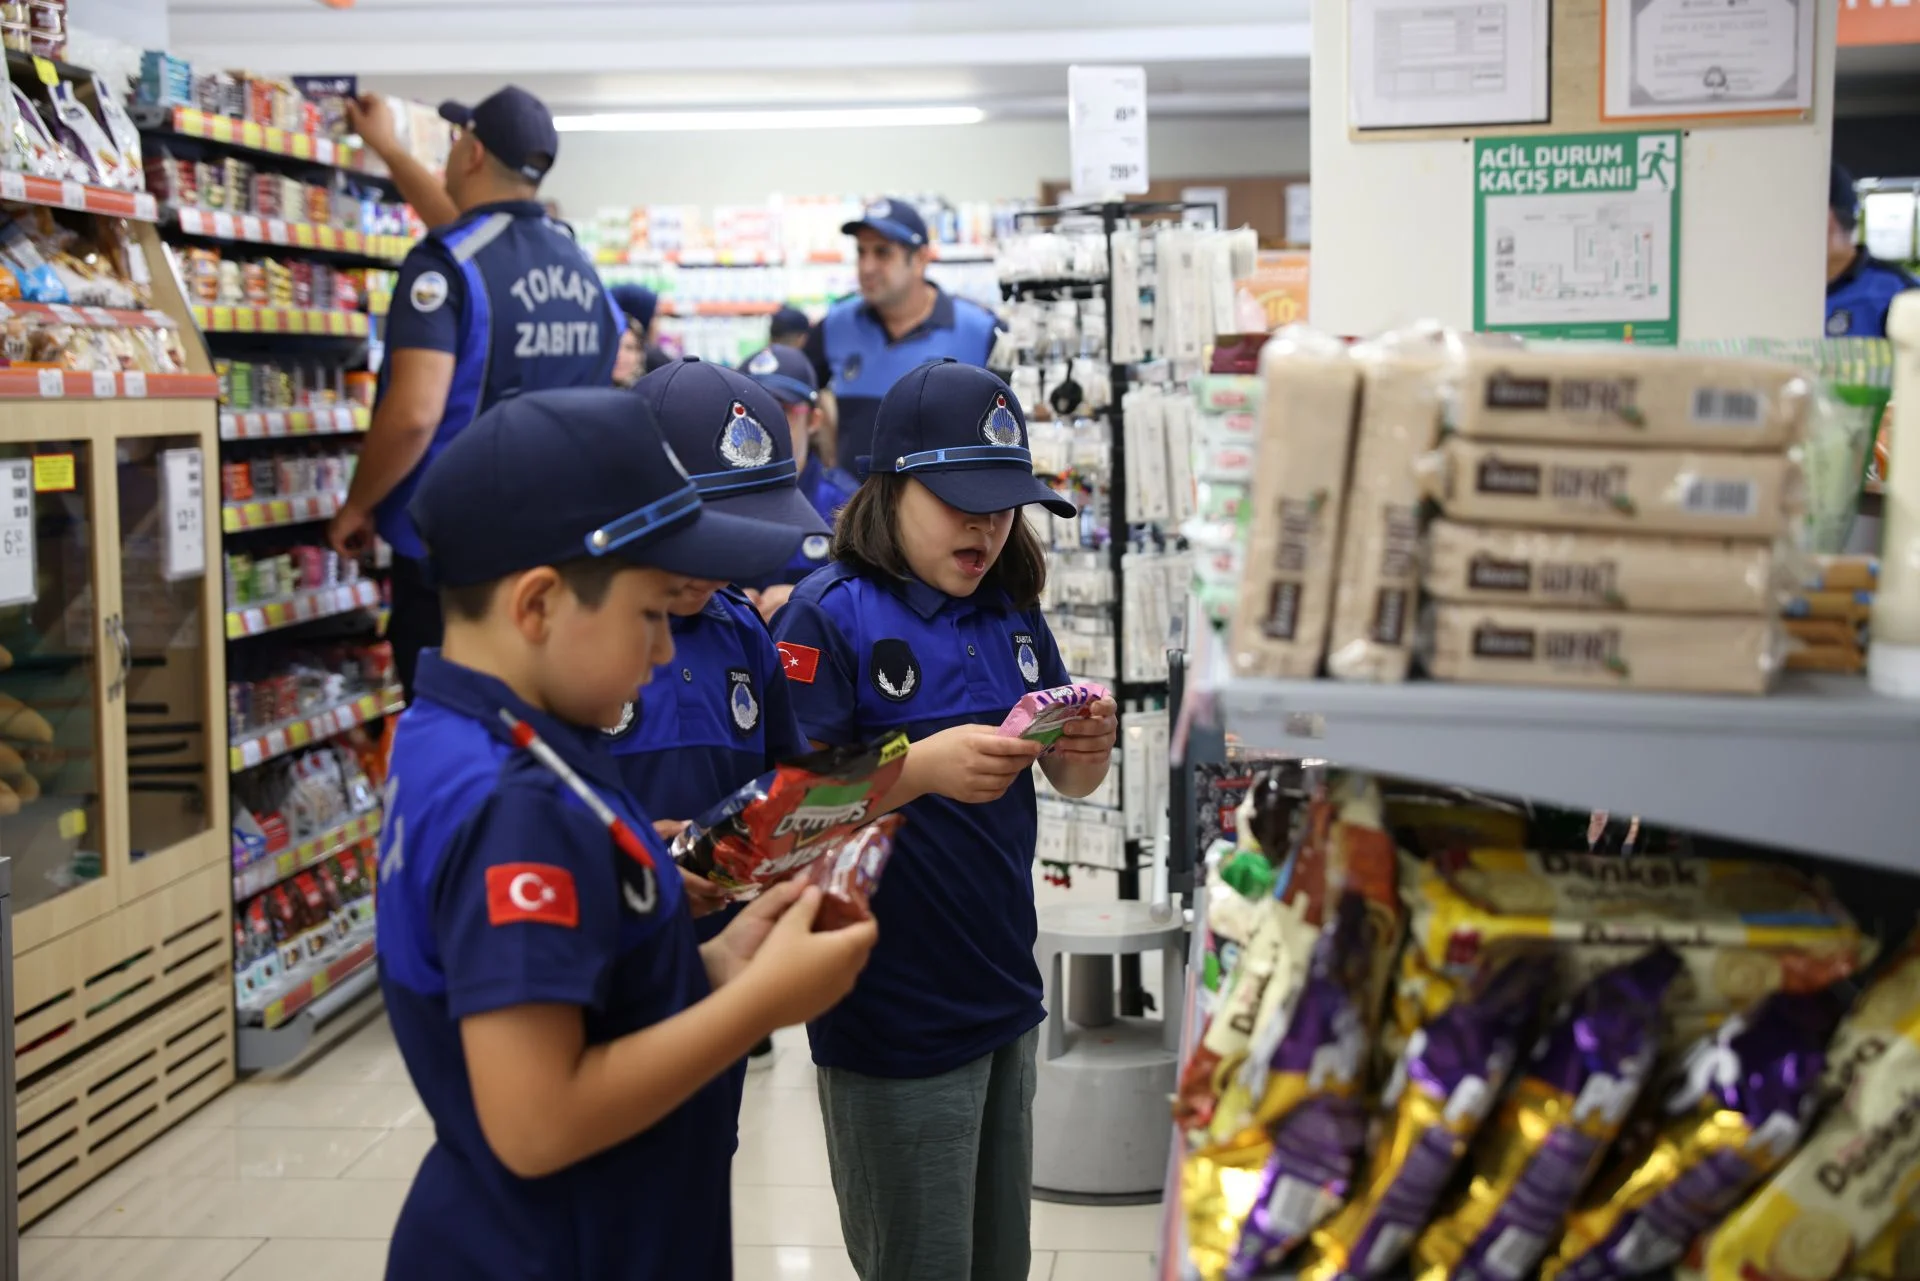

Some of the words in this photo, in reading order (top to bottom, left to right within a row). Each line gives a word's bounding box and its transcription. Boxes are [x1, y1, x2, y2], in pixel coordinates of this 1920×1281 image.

[1479, 144, 1530, 168] ACİL
[1535, 145, 1623, 167] DURUM
[1480, 168, 1549, 194] KAÇIŞ
[1553, 166, 1632, 189] PLANI!
[510, 264, 599, 313] TOKAT
[514, 321, 600, 357] ZABITA
